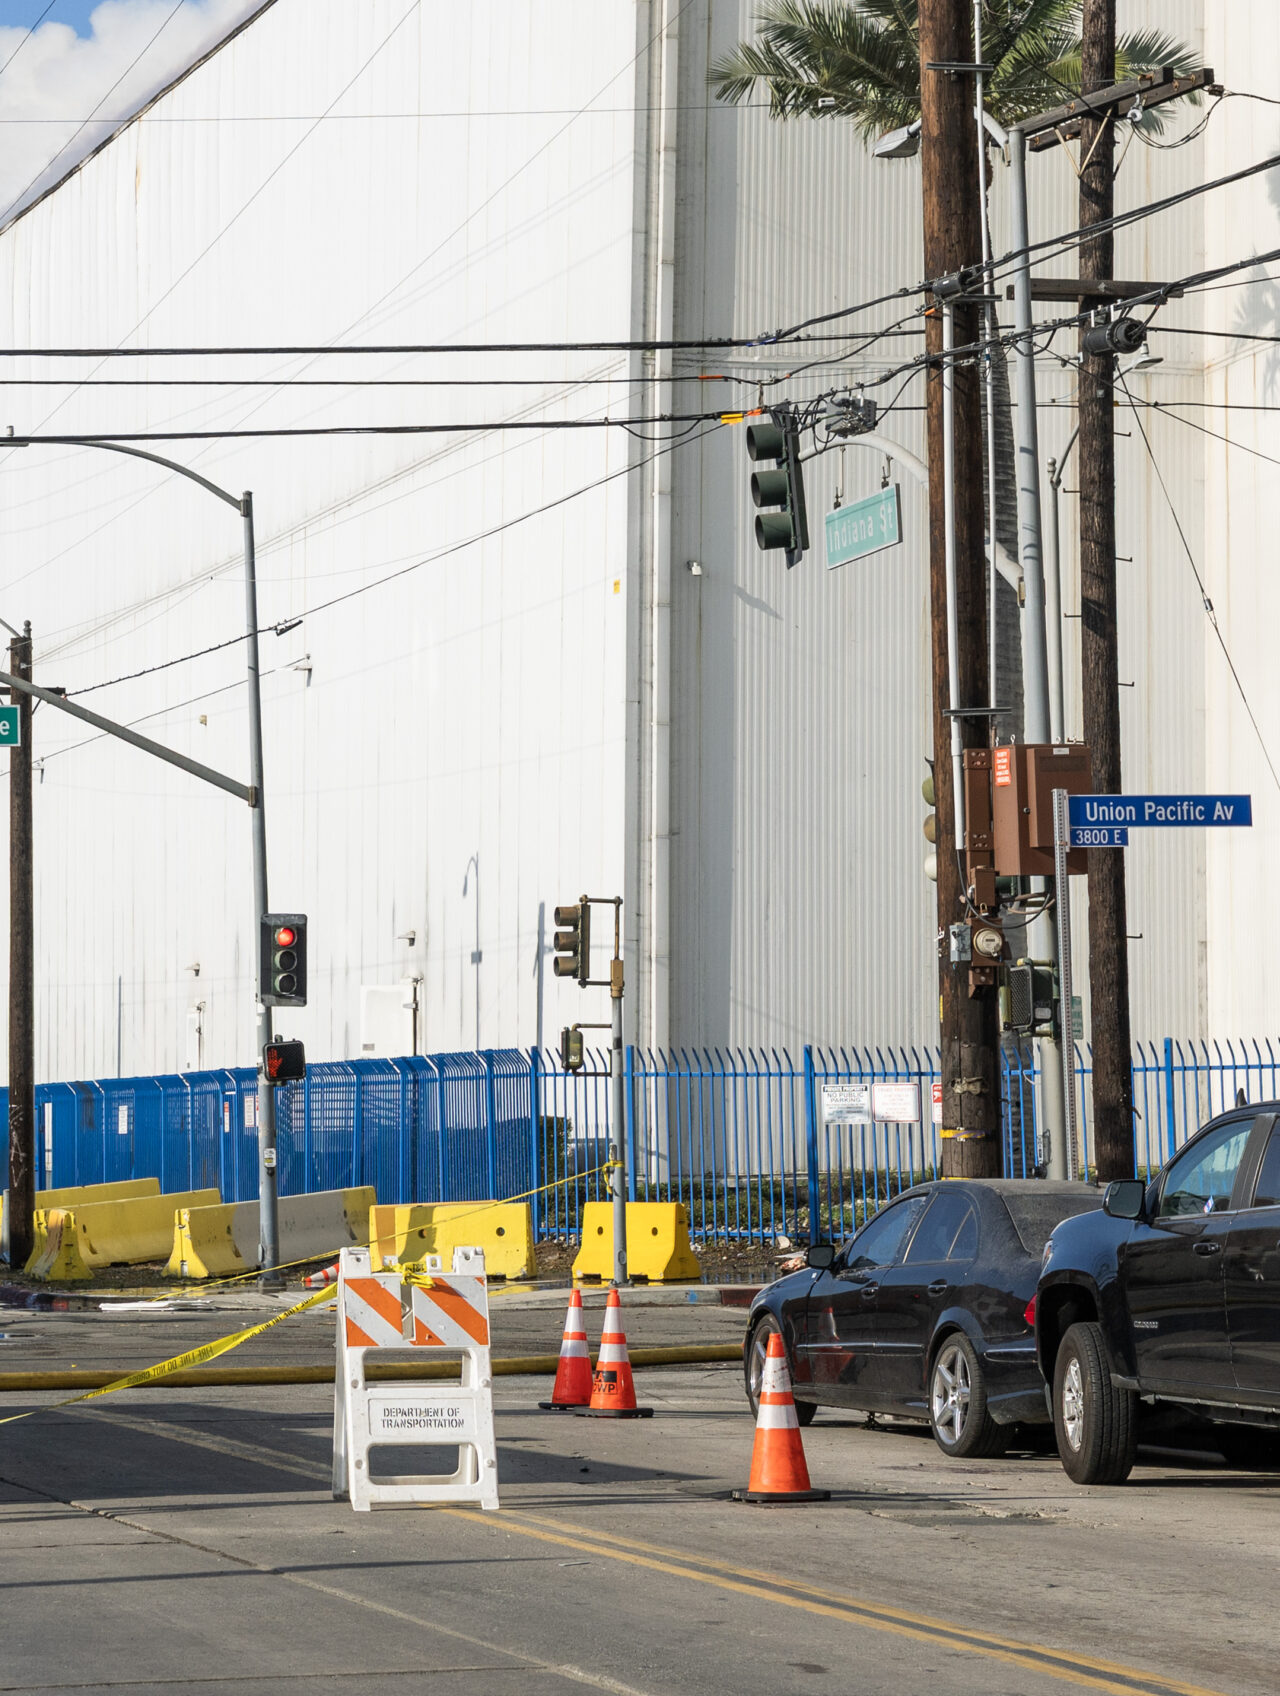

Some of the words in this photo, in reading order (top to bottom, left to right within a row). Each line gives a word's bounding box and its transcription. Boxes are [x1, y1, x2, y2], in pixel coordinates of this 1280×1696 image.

[829, 515, 874, 553] Indiana
[880, 501, 893, 532] St
[1085, 802, 1136, 821] Union
[1144, 801, 1205, 821] Pacific
[1213, 802, 1234, 820] Av
[1075, 829, 1108, 844] 3800
[1114, 830, 1121, 844] E
[447, 1407, 460, 1418] OF
[381, 1418, 465, 1429] TRANSPORTATION
